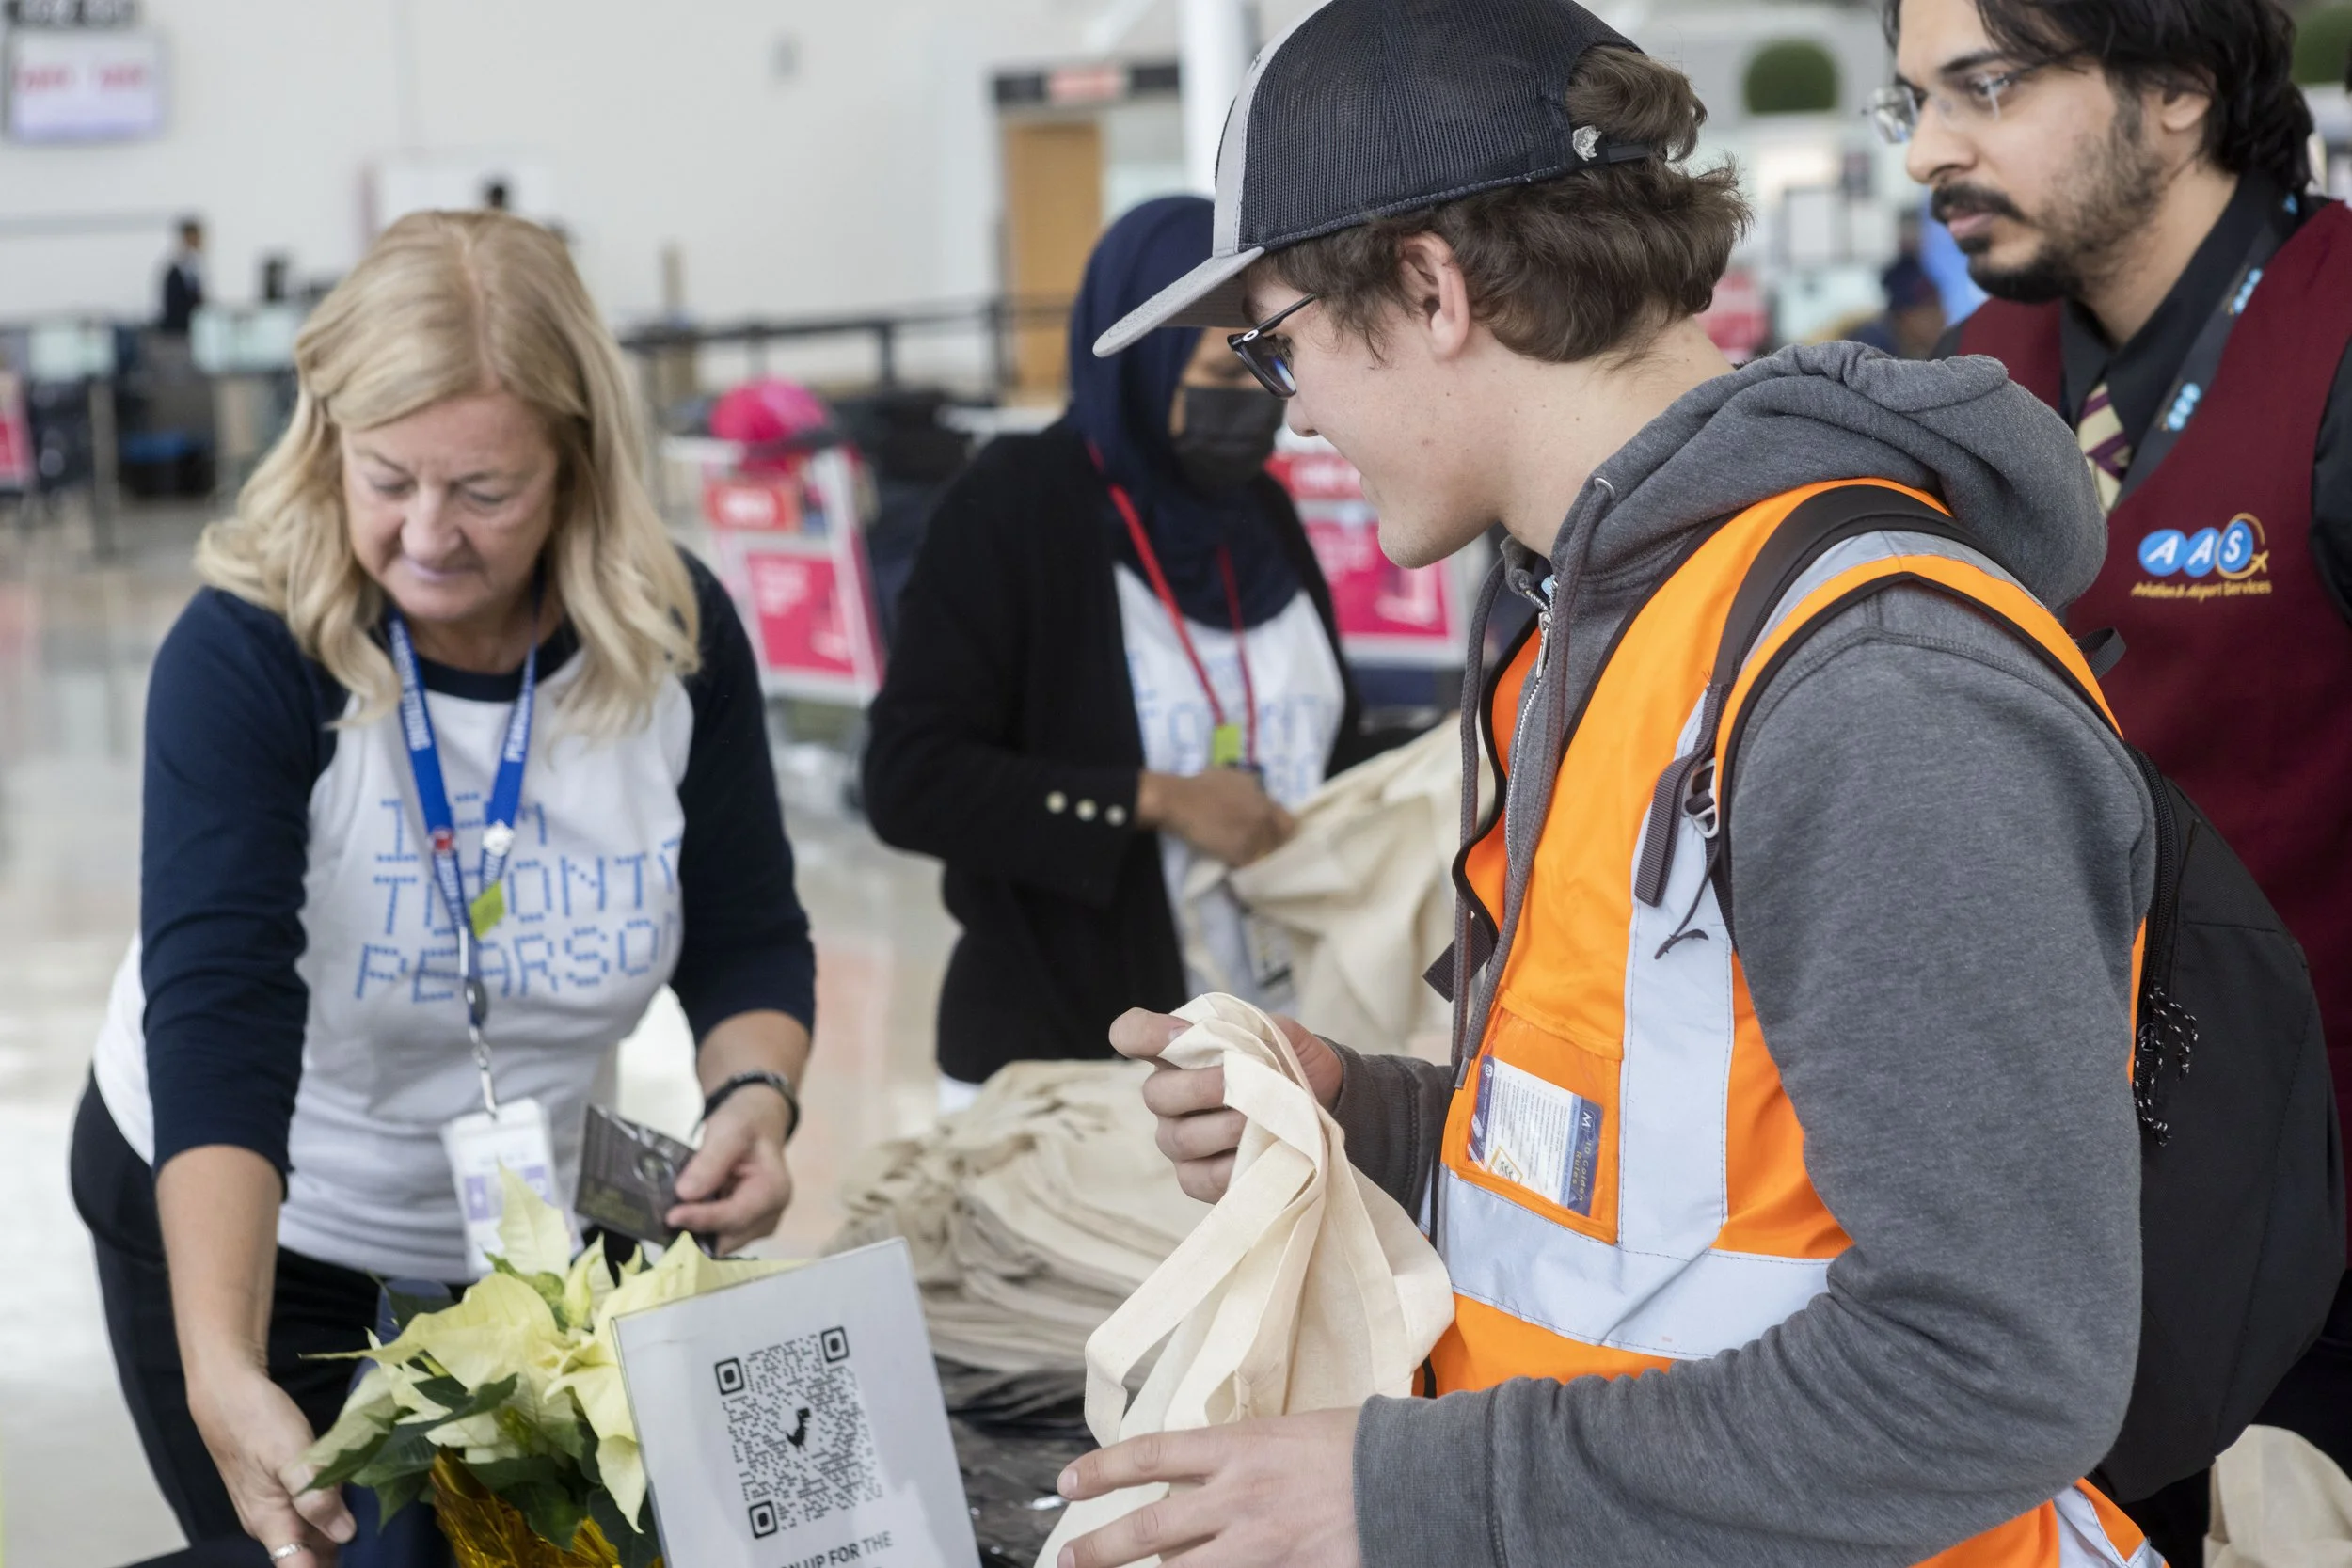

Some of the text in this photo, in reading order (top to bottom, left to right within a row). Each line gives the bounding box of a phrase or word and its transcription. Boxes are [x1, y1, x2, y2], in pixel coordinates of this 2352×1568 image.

[2143, 527, 2247, 567] AAS
[356, 912, 681, 1005] PEARSO
[1581, 1111, 1593, 1129] M
[1572, 1150, 1582, 1185] Rules
[1578, 1160, 1589, 1202] Golden
[828, 1543, 861, 1567] FOR
[861, 1529, 894, 1555] THE
